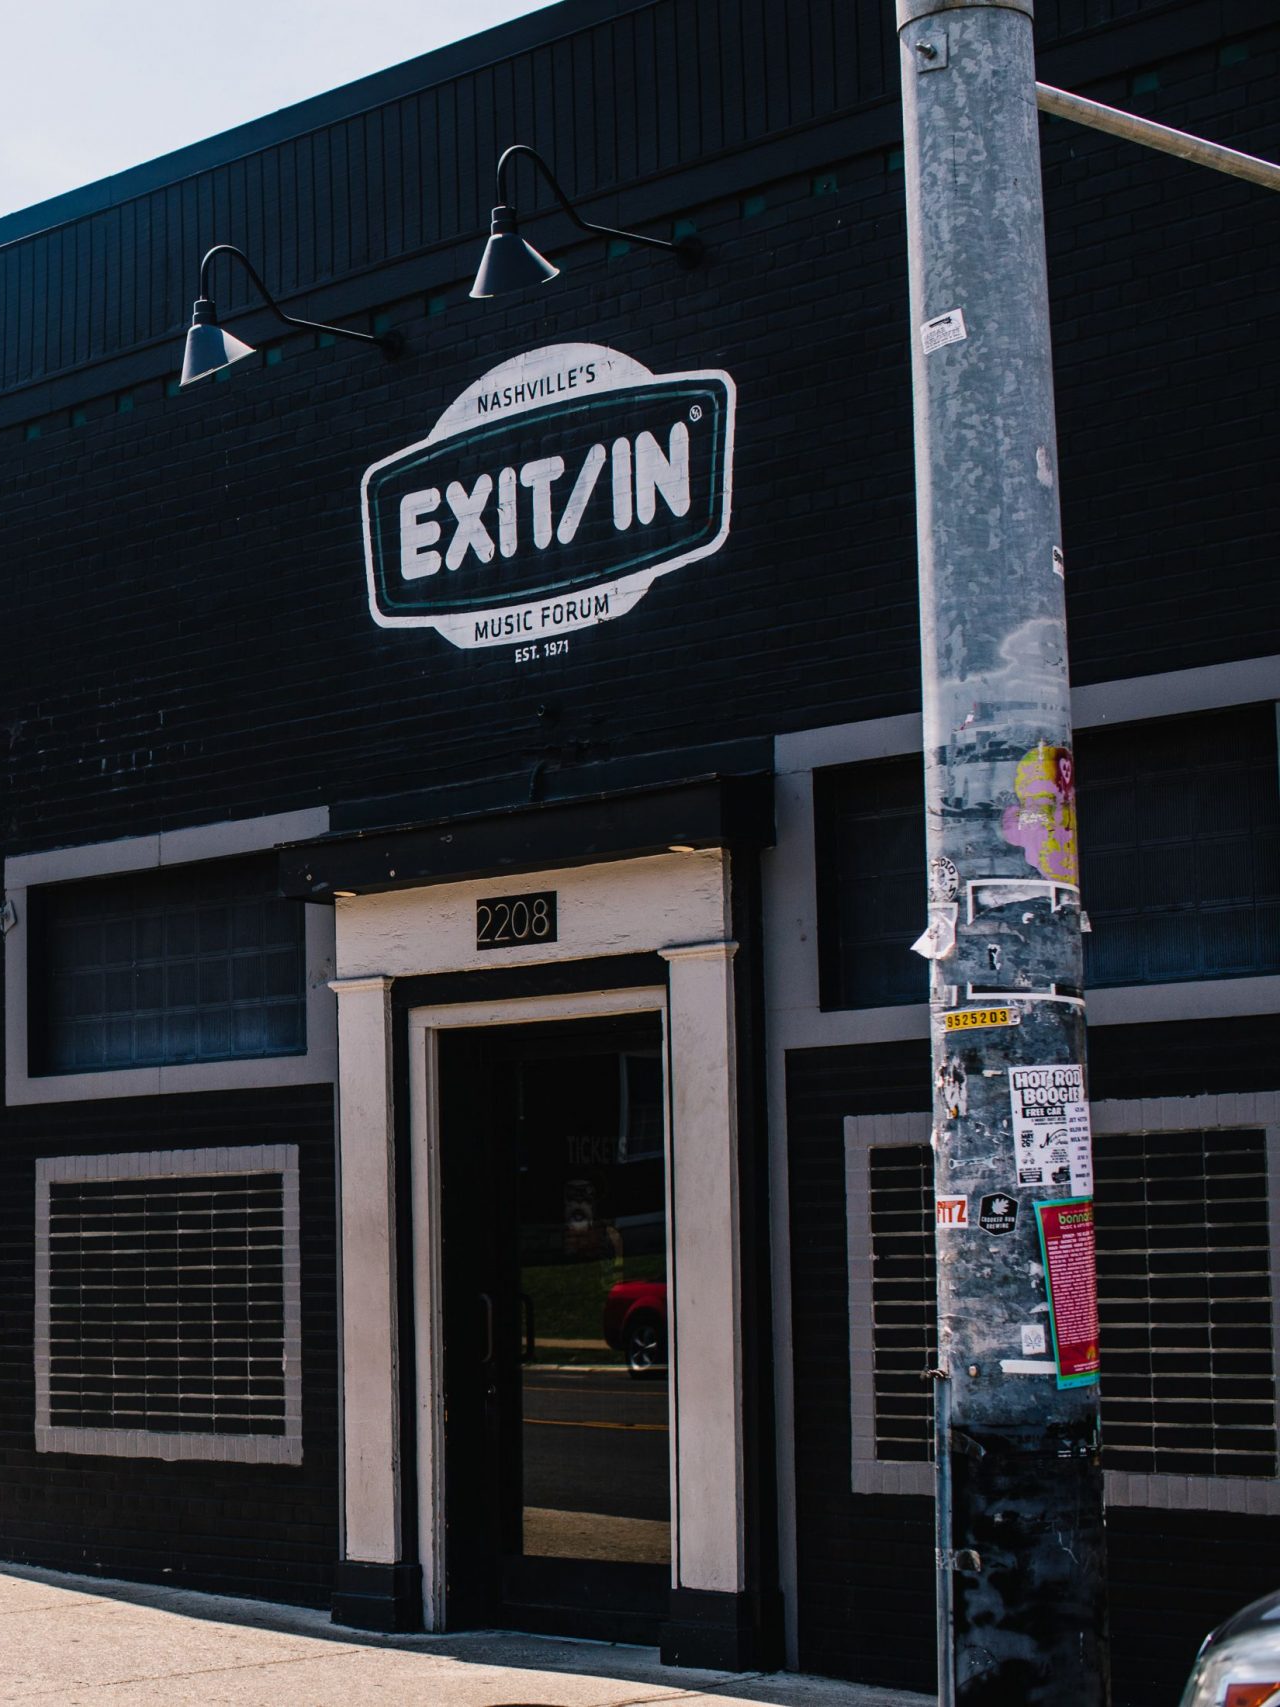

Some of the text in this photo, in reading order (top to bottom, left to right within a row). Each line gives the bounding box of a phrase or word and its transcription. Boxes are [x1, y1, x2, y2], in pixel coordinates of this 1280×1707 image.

[477, 363, 596, 414] NASHVILLE'S
[399, 421, 690, 580] EXIT/IN
[474, 594, 609, 641] MUSIC FORUM
[515, 639, 569, 663] EST. 1971
[477, 899, 548, 942] 2208
[947, 1010, 1007, 1028] 9525203
[1014, 1070, 1080, 1090] HOT ROD
[1022, 1087, 1080, 1106] BOOGIE
[1026, 1107, 1061, 1117] FREE CAR
